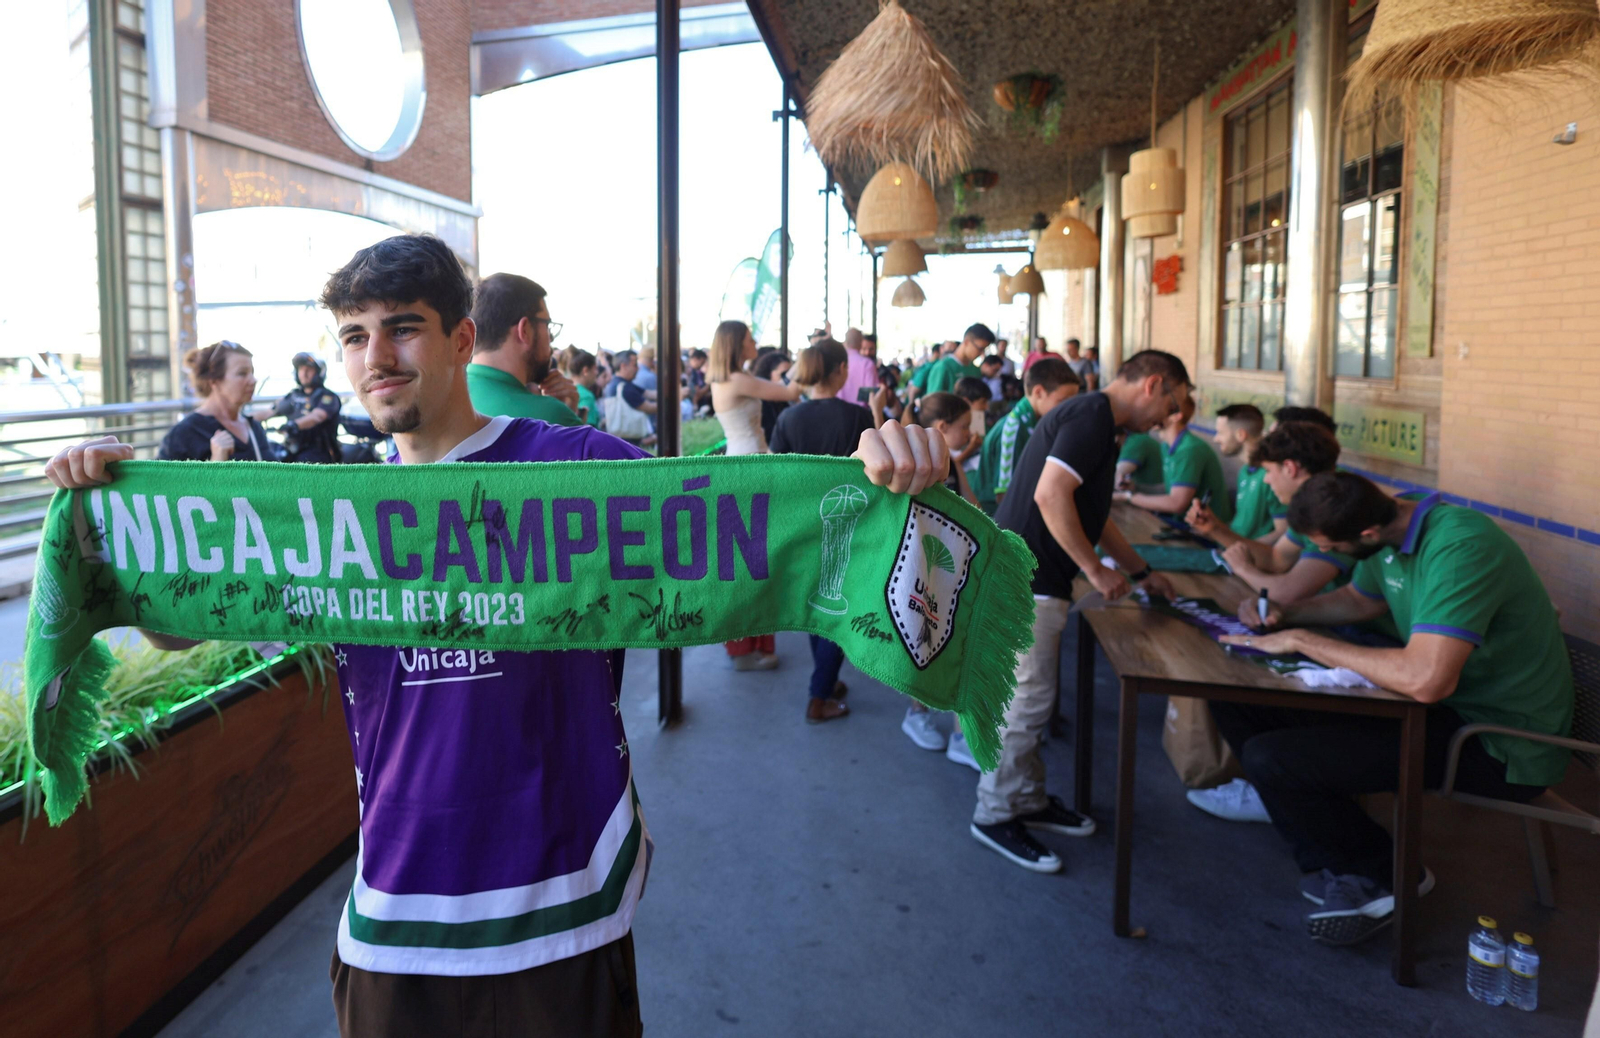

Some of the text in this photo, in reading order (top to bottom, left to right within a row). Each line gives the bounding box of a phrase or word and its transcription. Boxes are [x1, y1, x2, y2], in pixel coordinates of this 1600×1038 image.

[1361, 416, 1417, 451] PICTURE
[282, 583, 342, 620] COPA
[350, 588, 394, 622] DEL
[401, 589, 448, 623] REY
[457, 591, 525, 626] 2023
